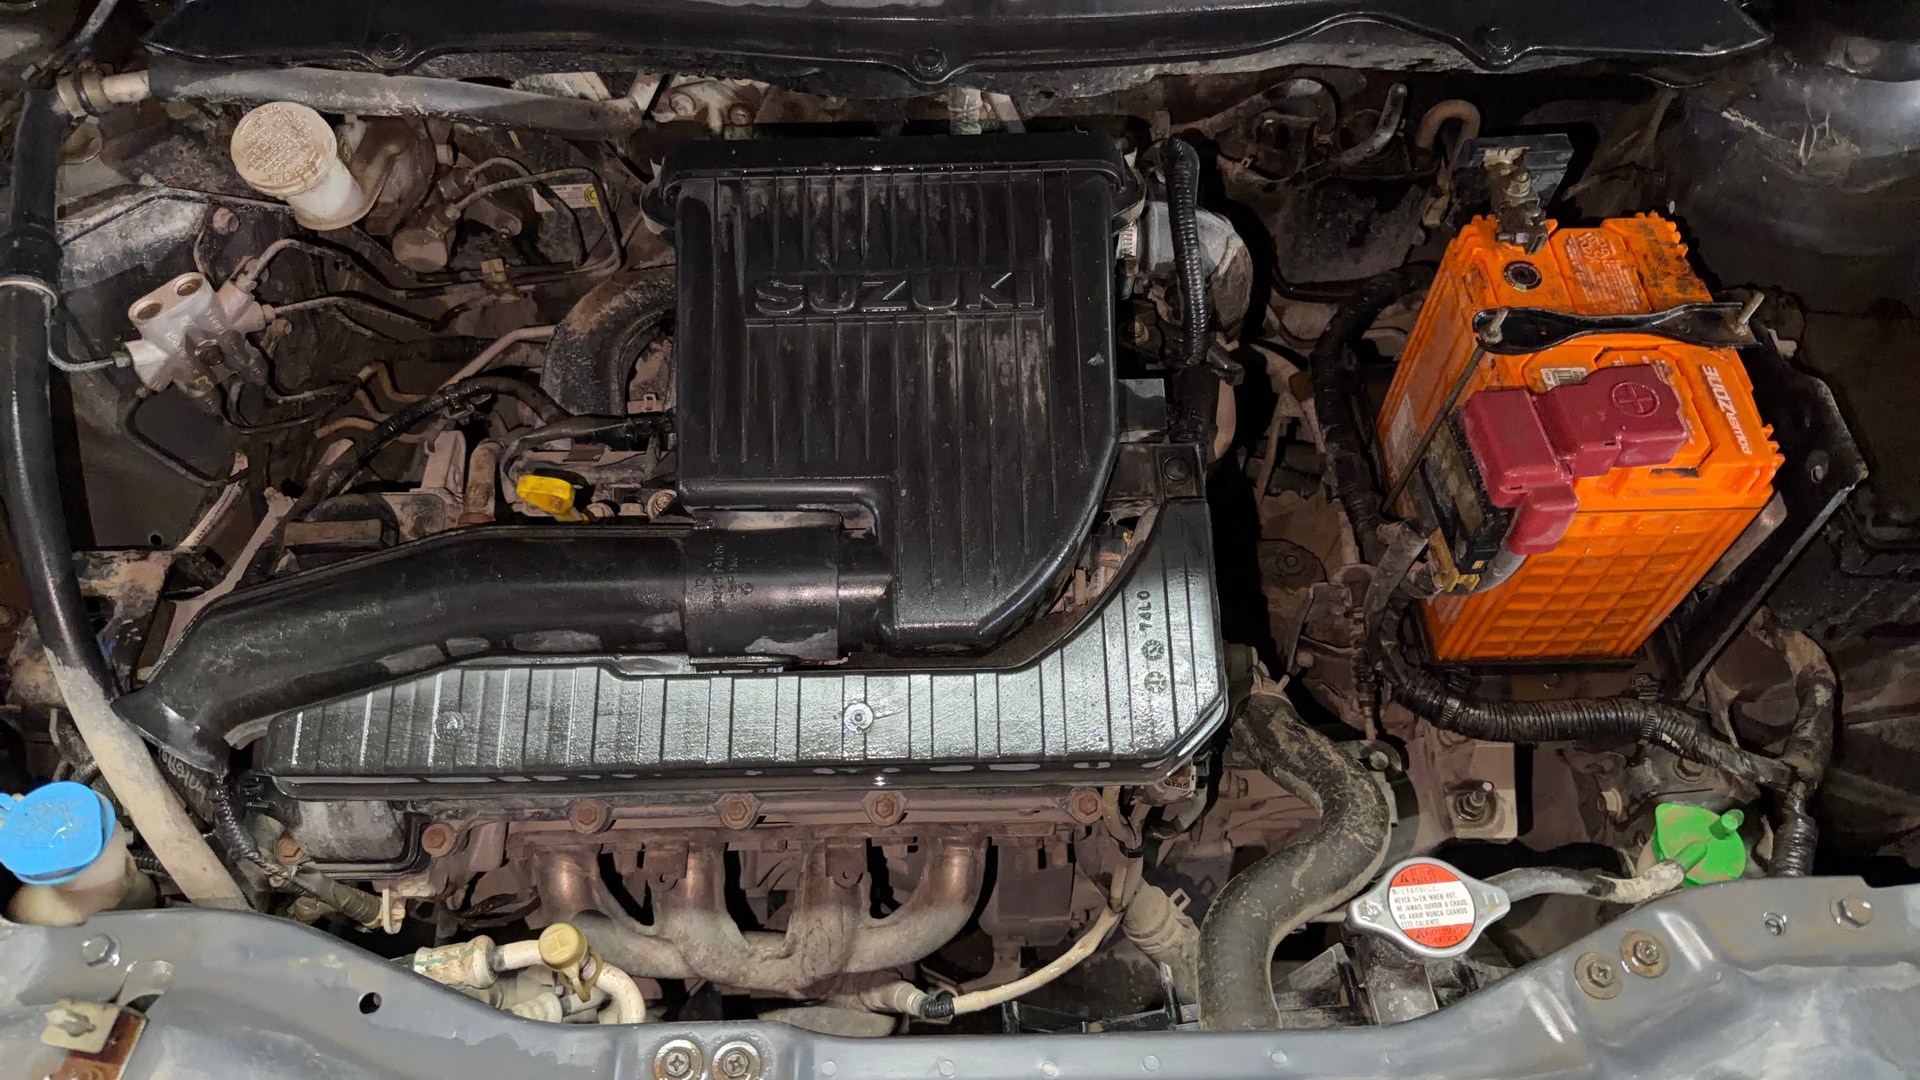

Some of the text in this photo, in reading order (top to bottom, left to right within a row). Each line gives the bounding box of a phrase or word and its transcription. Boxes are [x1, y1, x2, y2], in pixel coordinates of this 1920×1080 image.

[754, 271, 1036, 315] SUZUKI
[1394, 896, 1411, 904] NEVER
[1428, 893, 1444, 902] WHEN
[1405, 903, 1423, 912] JAMAIS
[1398, 912, 1406, 920] NO
[1425, 908, 1444, 918] NUNCA
[1446, 907, 1468, 915] CUANDO
[1400, 920, 1414, 929] ESTE
